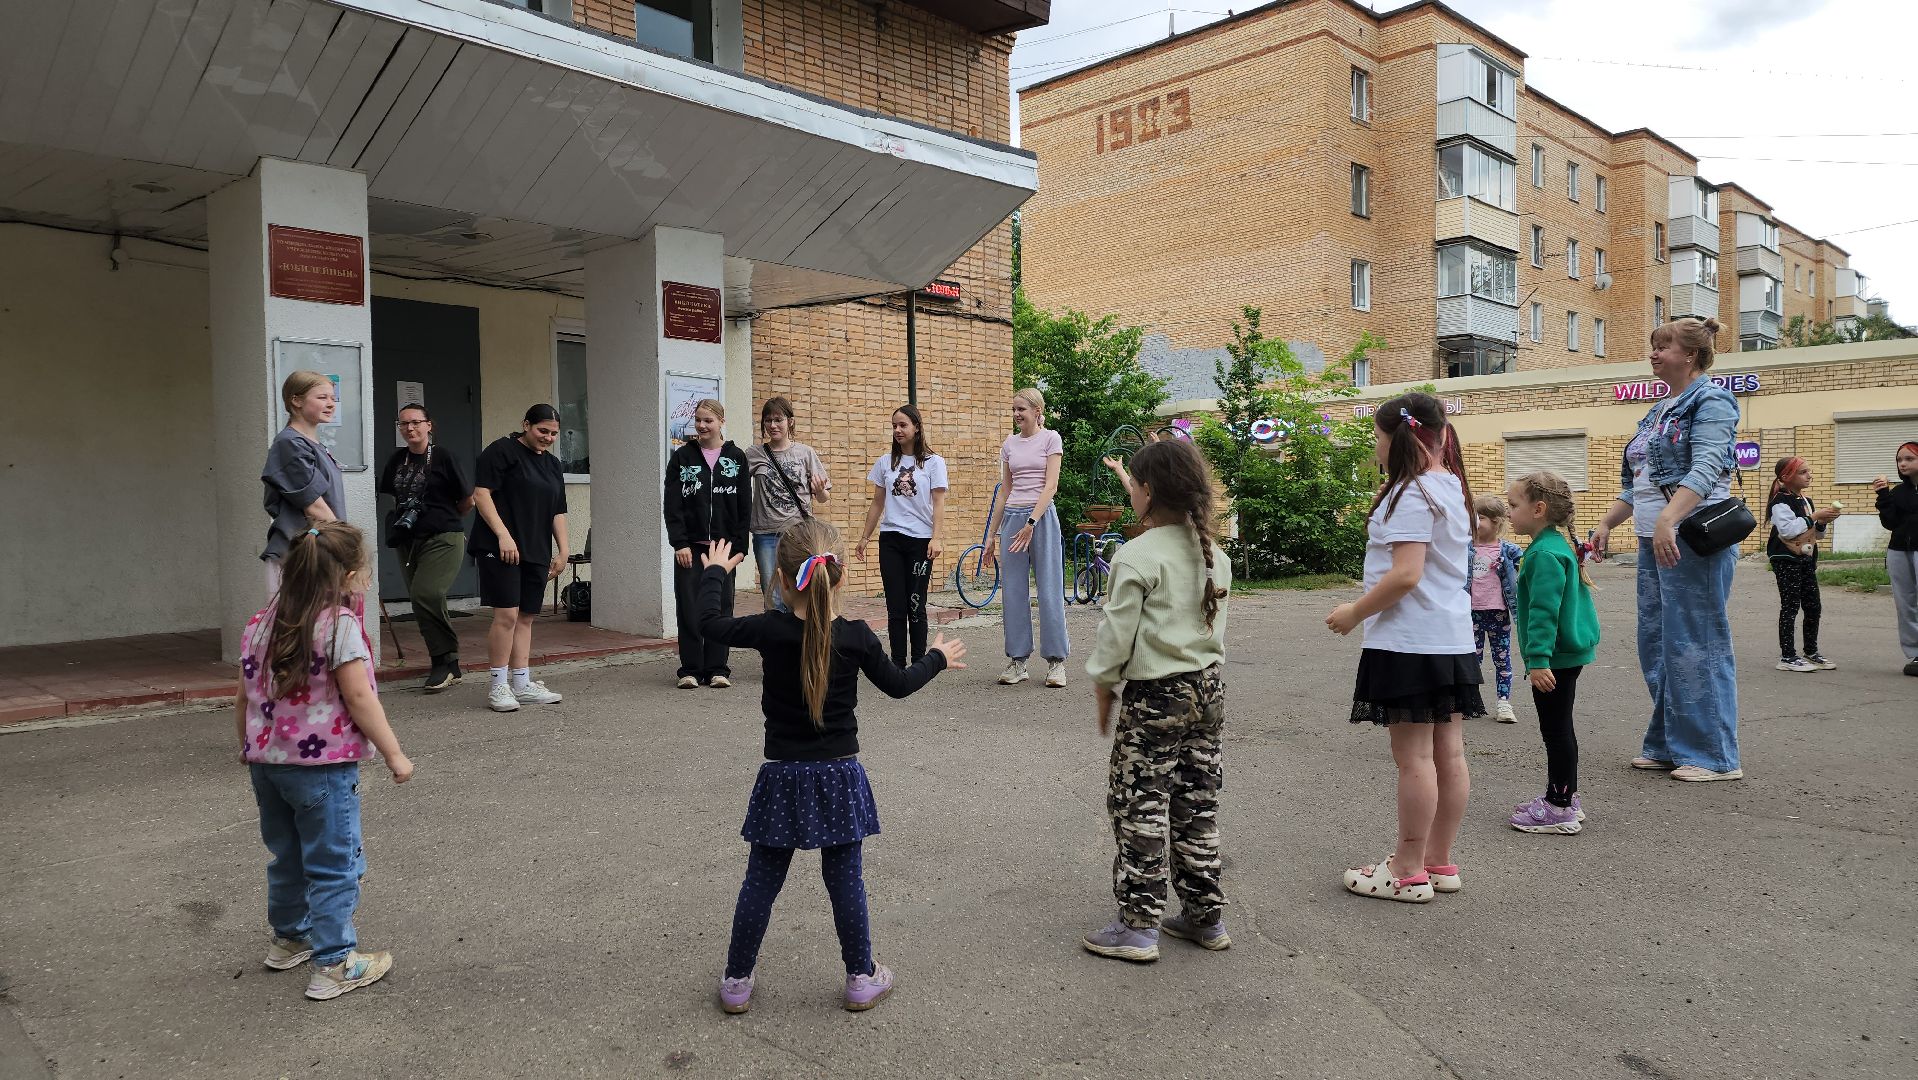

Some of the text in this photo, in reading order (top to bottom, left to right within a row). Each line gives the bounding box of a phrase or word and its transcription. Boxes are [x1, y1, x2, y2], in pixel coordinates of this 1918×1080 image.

[1096, 87, 1192, 155] 1983
[1613, 373, 1761, 400] WILDRIES
[1736, 447, 1758, 460] WB
